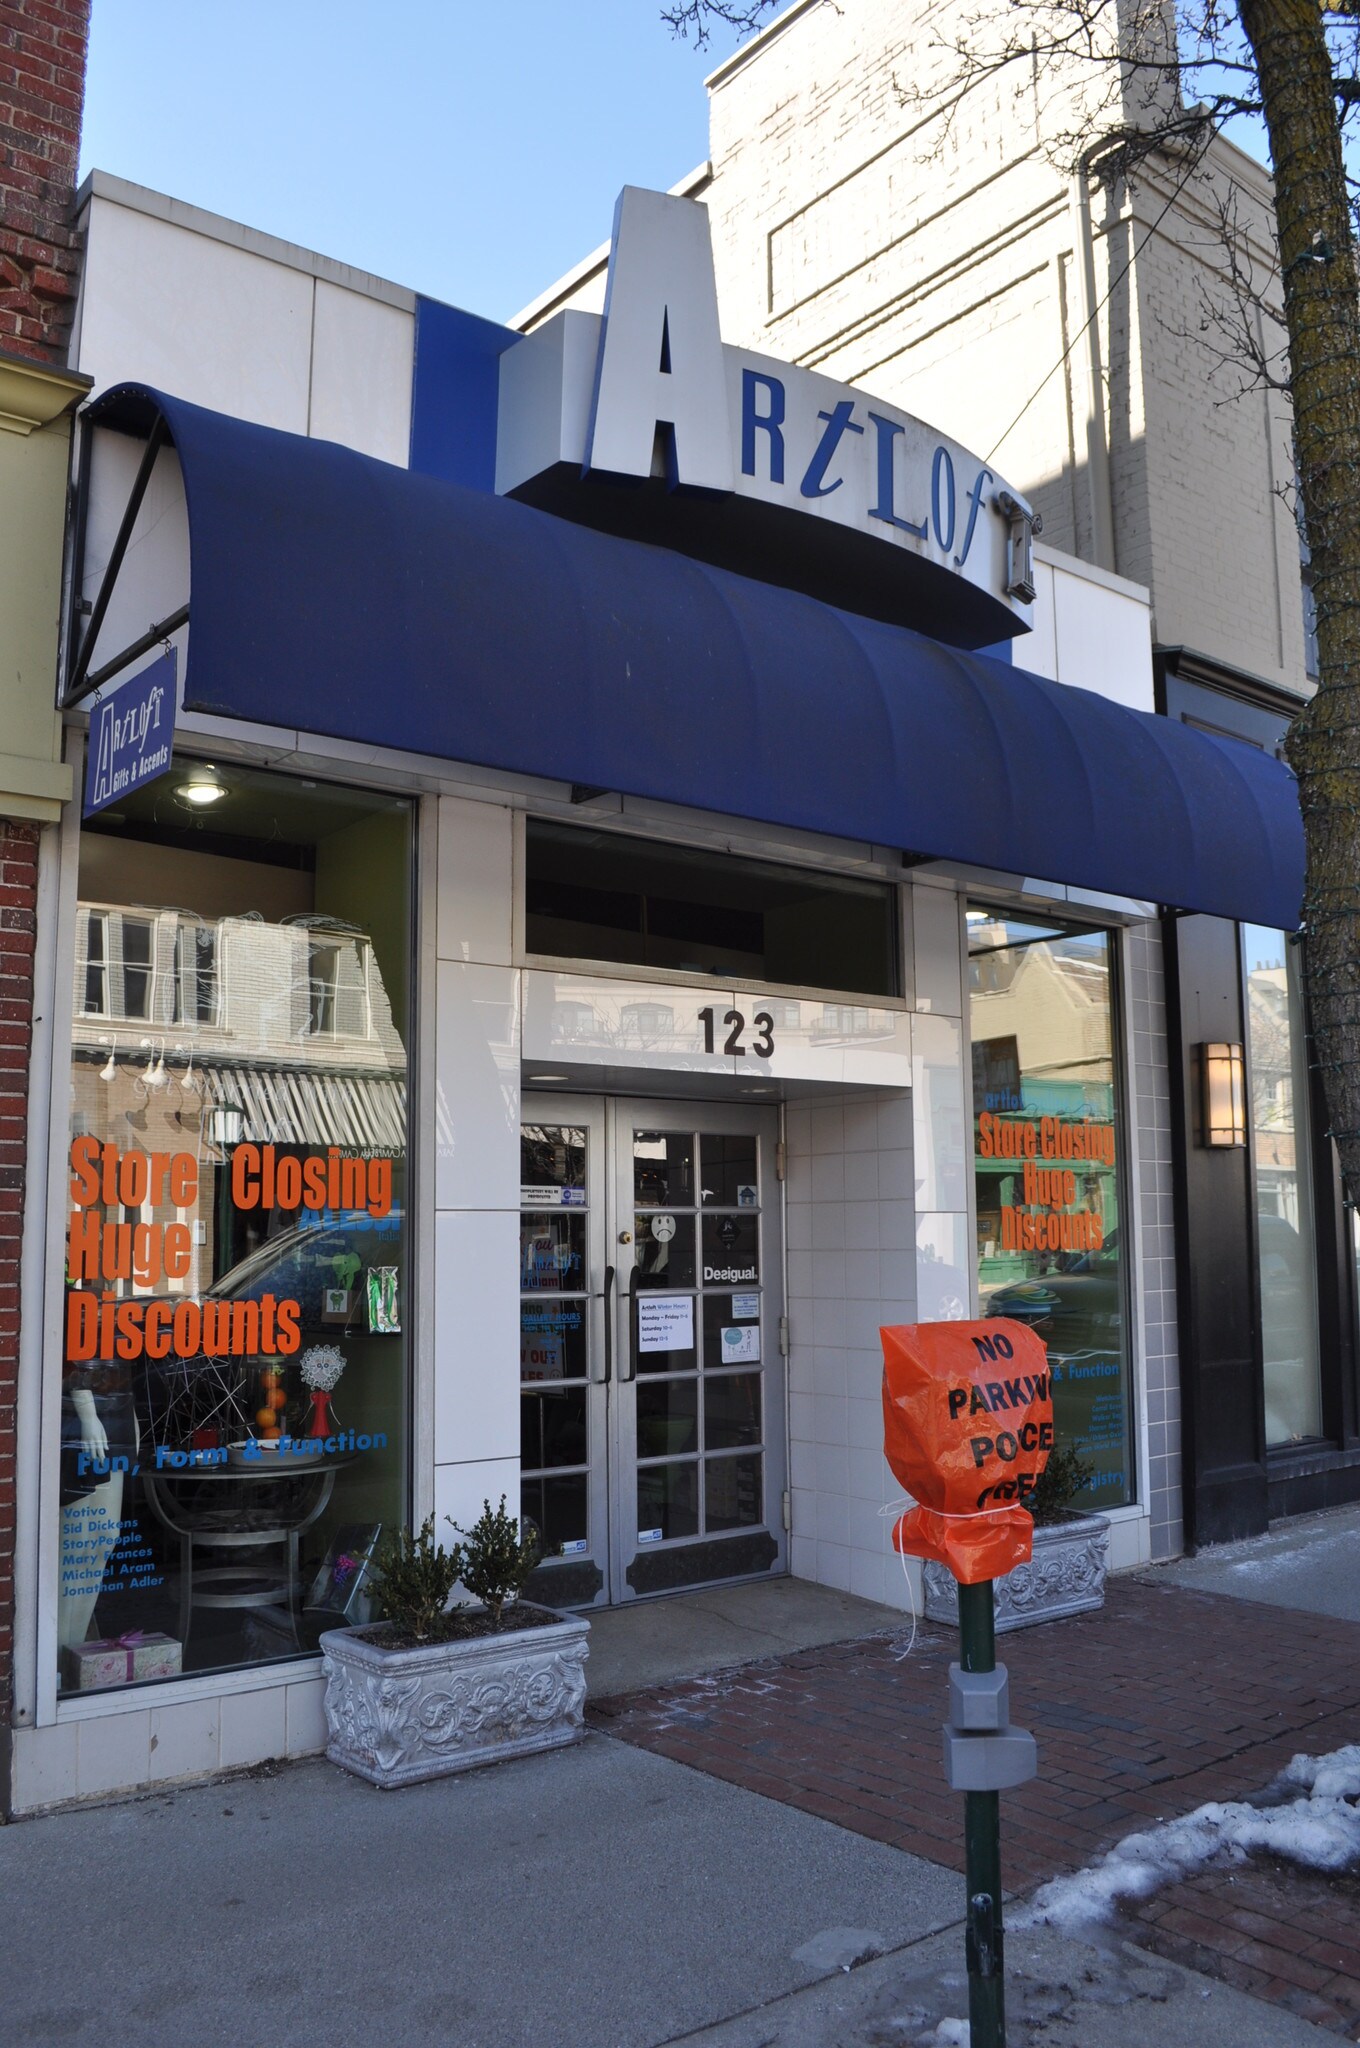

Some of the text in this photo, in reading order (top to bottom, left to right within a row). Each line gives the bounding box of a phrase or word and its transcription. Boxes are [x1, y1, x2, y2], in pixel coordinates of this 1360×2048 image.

[112, 744, 169, 793] Gifts & Accents
[697, 1007, 776, 1060] 123
[978, 1112, 1115, 1167] Store Closing
[69, 1136, 392, 1218] Store Closing
[1023, 1162, 1076, 1211] Huge
[67, 1210, 192, 1288] Huge
[1001, 1206, 1104, 1252] Discounts
[66, 1291, 301, 1361] Discounts
[971, 1333, 1014, 1363] NO
[1053, 1362, 1119, 1381] & Function
[76, 1428, 389, 1478] Fun, Form & Function
[63, 1506, 107, 1519] Votivo
[63, 1518, 139, 1535] Sid Dickens
[62, 1532, 142, 1551] StoryPeople
[62, 1547, 153, 1567] Mary Frances
[62, 1561, 155, 1582] Michael Aram
[62, 1575, 165, 1598] Jonathan Adler
